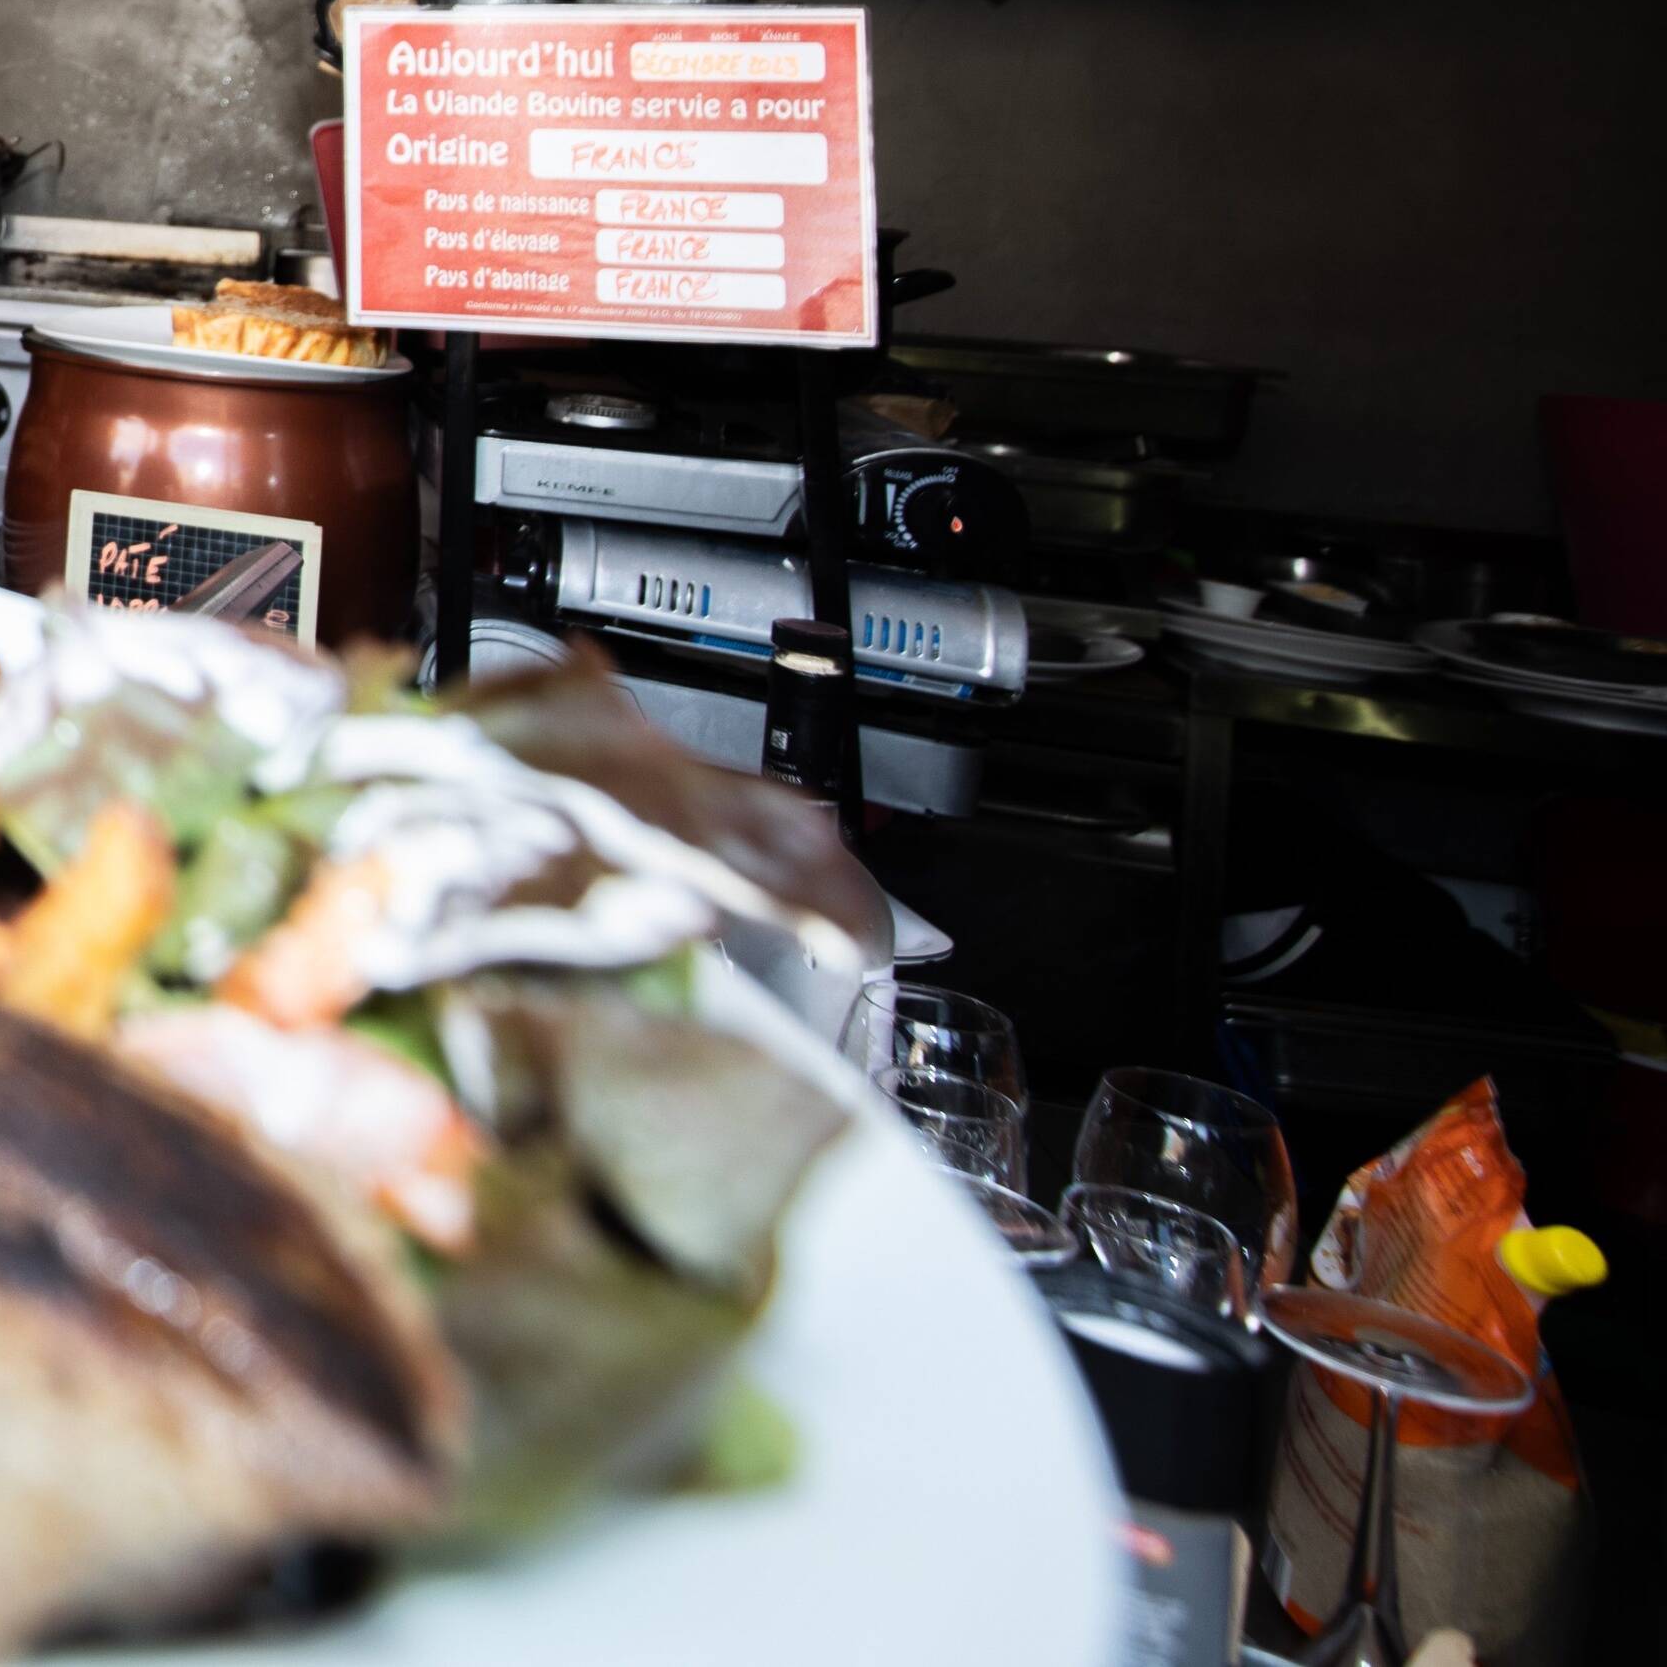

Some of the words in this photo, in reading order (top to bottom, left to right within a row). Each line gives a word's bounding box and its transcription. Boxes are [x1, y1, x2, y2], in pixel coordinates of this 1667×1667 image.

[710, 31, 740, 42] MOIS
[387, 40, 615, 78] Aujourd'hui
[386, 89, 418, 116] La
[425, 89, 519, 117] Viande
[527, 91, 622, 119] Bovine
[630, 94, 721, 120] servie
[730, 97, 748, 120] a
[757, 96, 826, 121] pour
[386, 132, 509, 167] Origine
[570, 140, 700, 173] FRANCE
[424, 189, 468, 214] Pays
[472, 191, 495, 213] de
[500, 193, 590, 216] naissance
[619, 193, 730, 222] FRANCE
[424, 227, 468, 251] Pays
[472, 229, 560, 253] d'élevage
[617, 231, 711, 261] FRANCE
[424, 265, 468, 289] Pays
[472, 267, 570, 293] d'abattage
[615, 269, 719, 302] FRANCE
